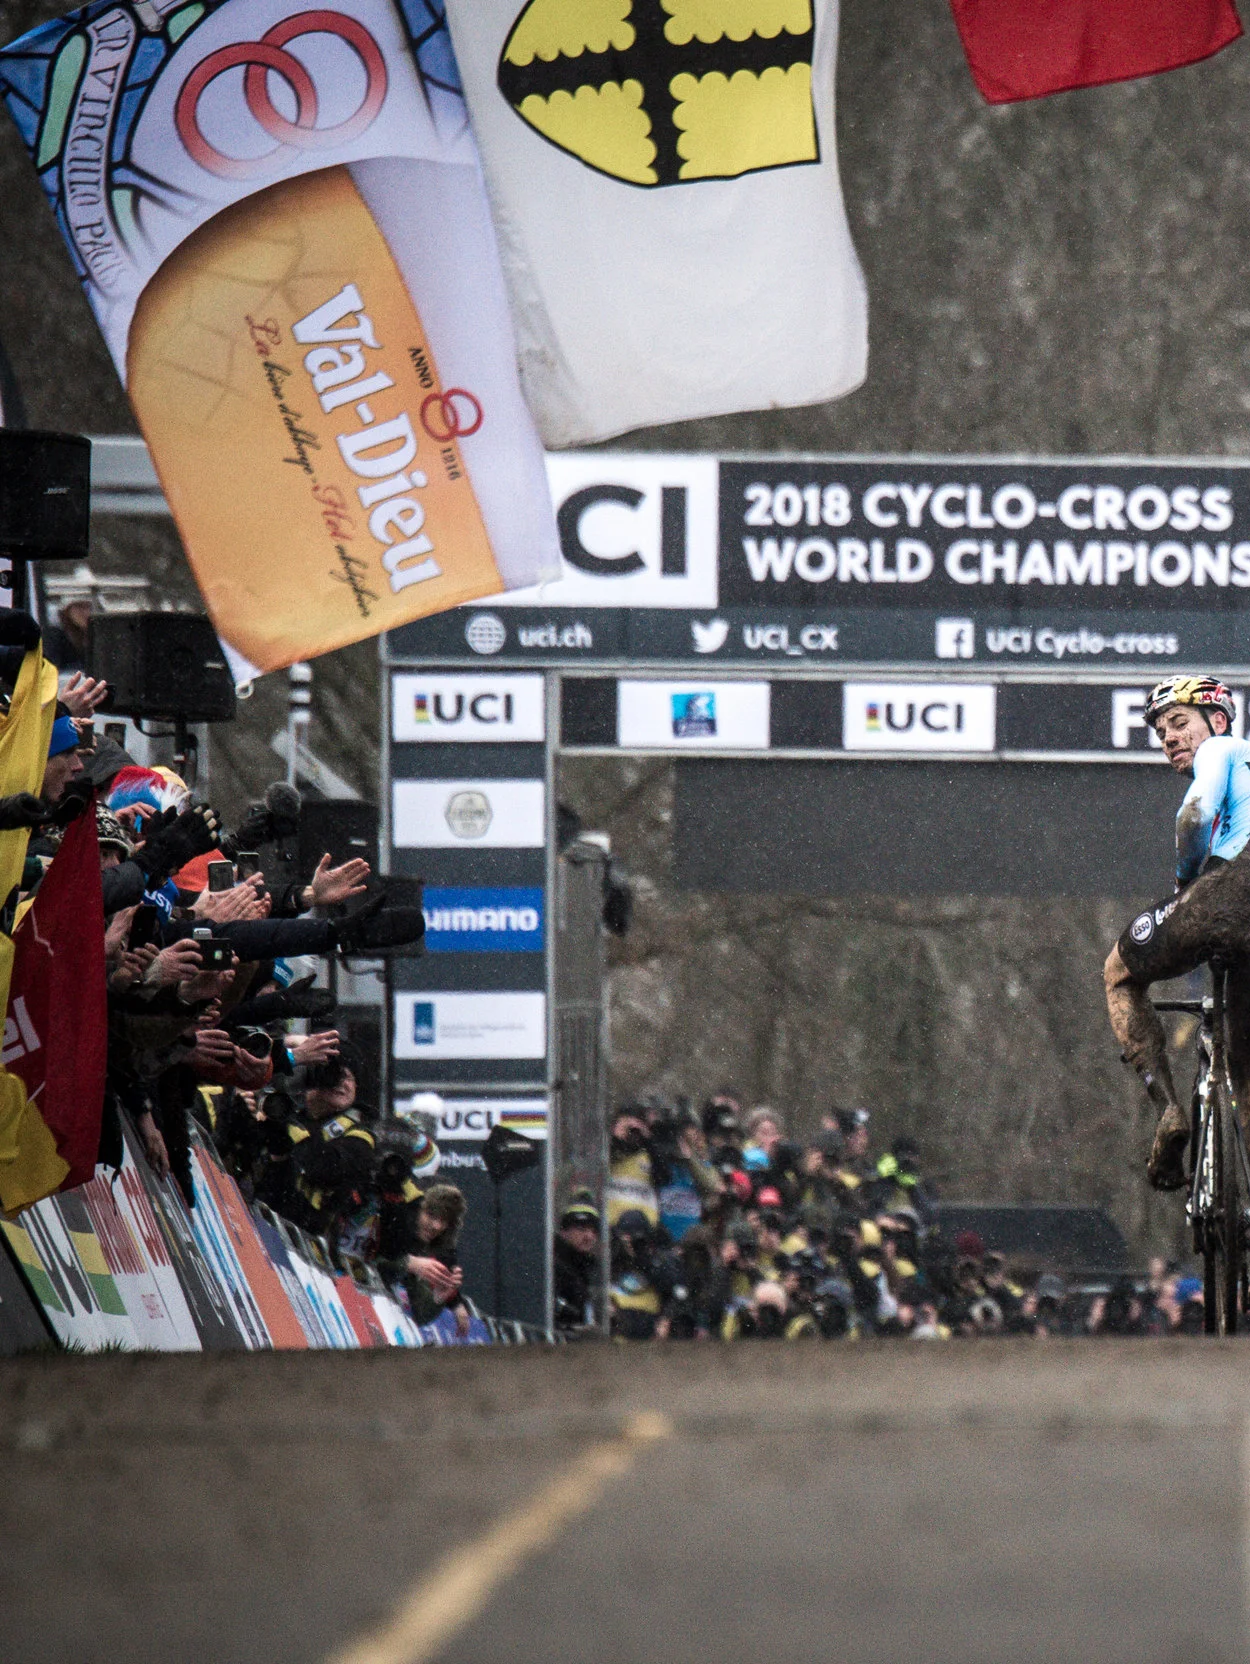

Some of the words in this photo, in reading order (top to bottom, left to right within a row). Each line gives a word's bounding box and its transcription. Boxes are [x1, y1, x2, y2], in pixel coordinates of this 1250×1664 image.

[408, 347, 434, 390] ANNO
[291, 283, 442, 593] Val-Dieu
[743, 483, 852, 527] 2018
[862, 483, 1234, 533] CYCLO-CROSS
[556, 485, 688, 577] CI
[743, 538, 934, 584] WORLD
[518, 624, 593, 649] uci.ch
[432, 693, 514, 724] UCI
[884, 703, 964, 732] UCI
[421, 907, 539, 932] HIMANO
[440, 1109, 496, 1132] UCI
